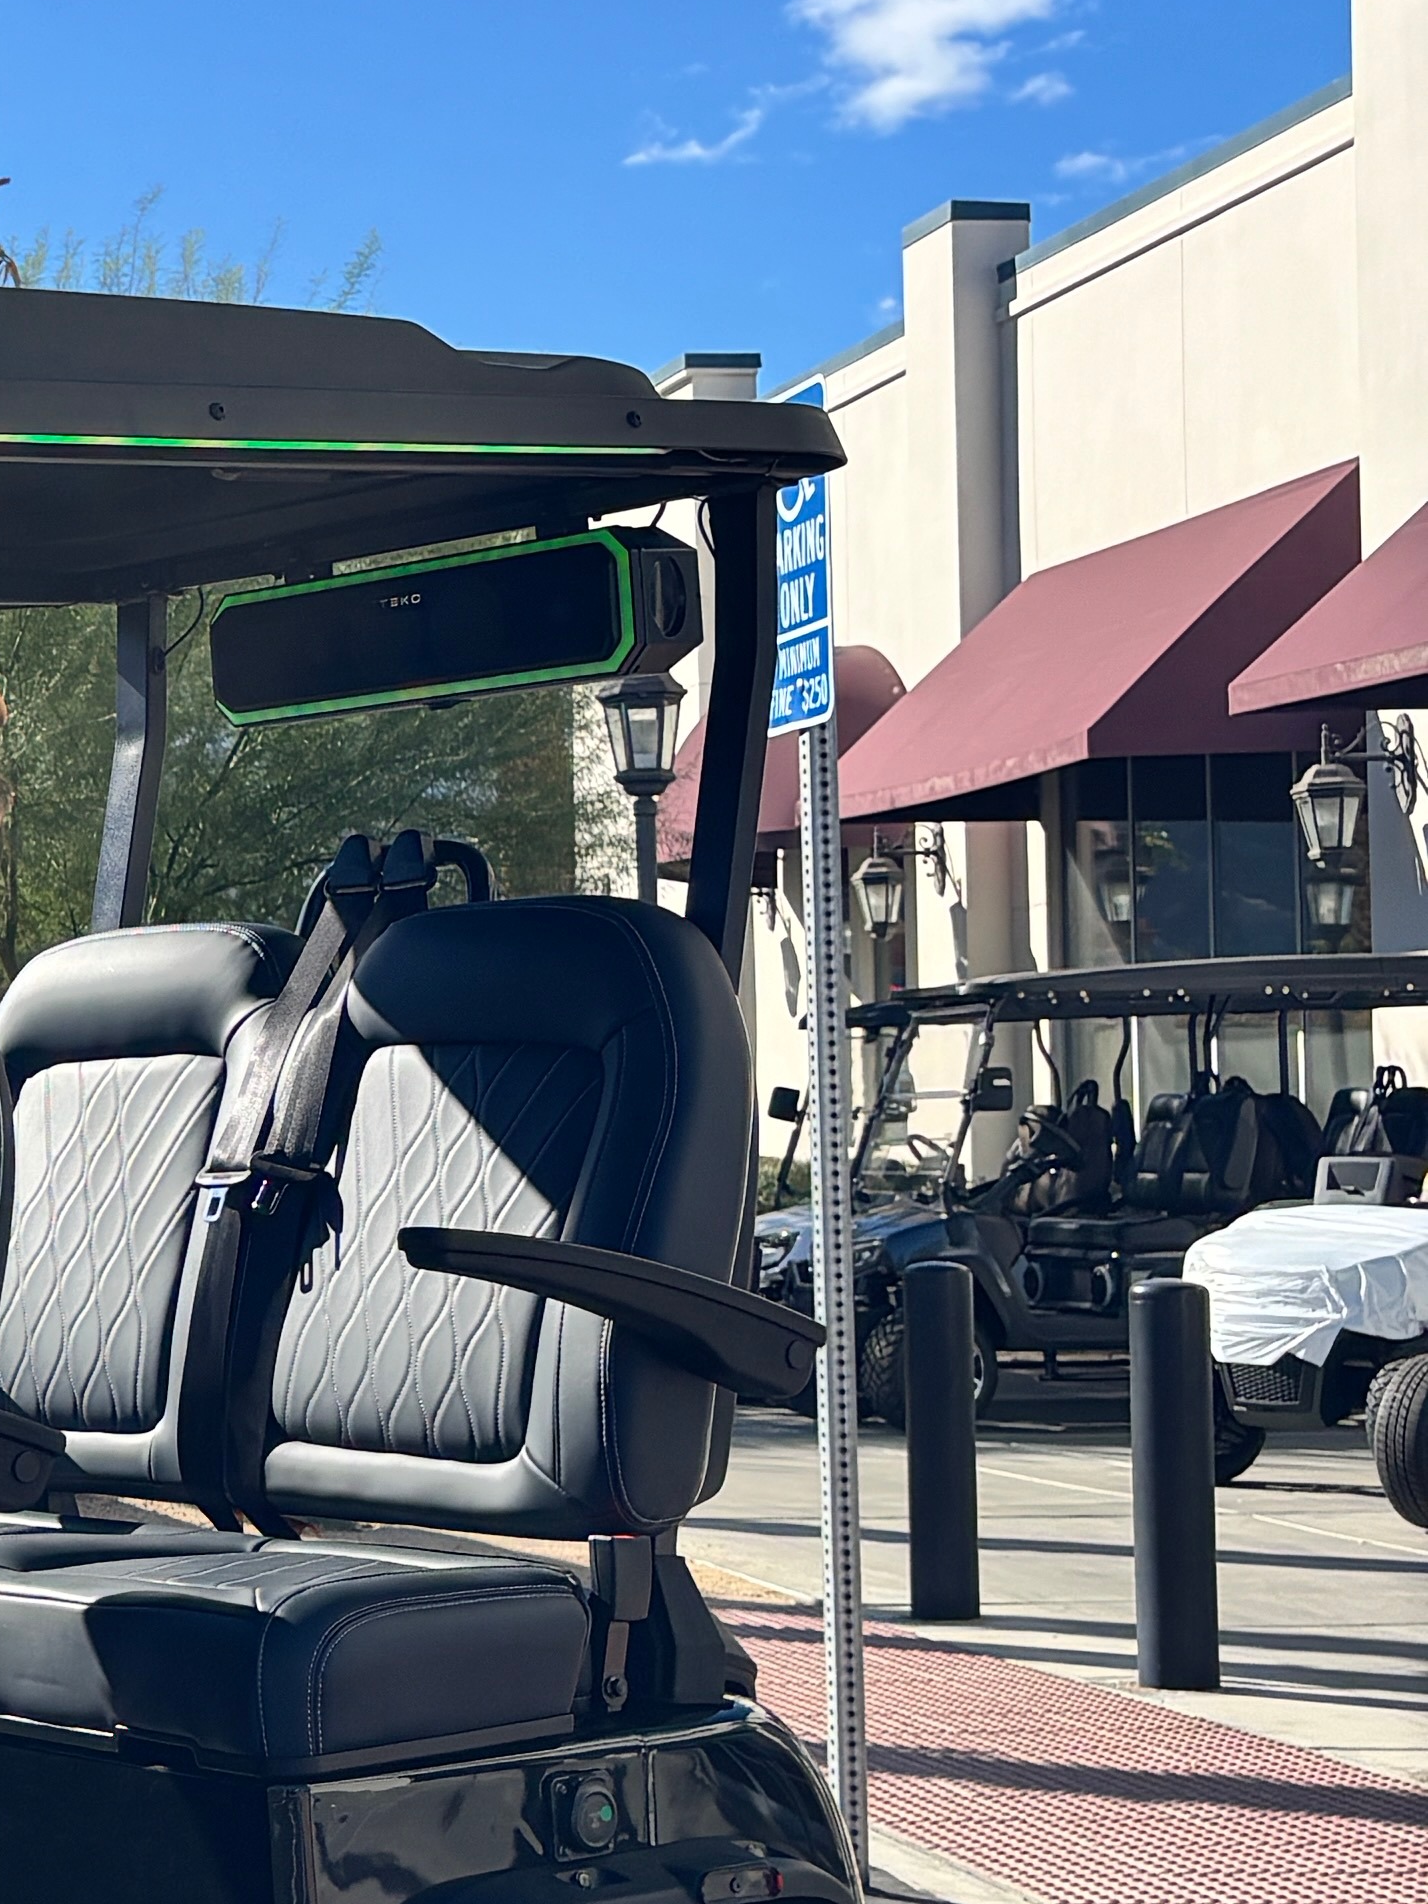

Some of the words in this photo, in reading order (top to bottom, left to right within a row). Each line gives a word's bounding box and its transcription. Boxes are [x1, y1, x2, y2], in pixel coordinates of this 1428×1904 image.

[776, 513, 824, 576] ARKING
[379, 593, 421, 608] TEKO
[780, 572, 815, 627] ONLY
[778, 636, 821, 681] MINIMUM
[801, 673, 828, 715] $250
